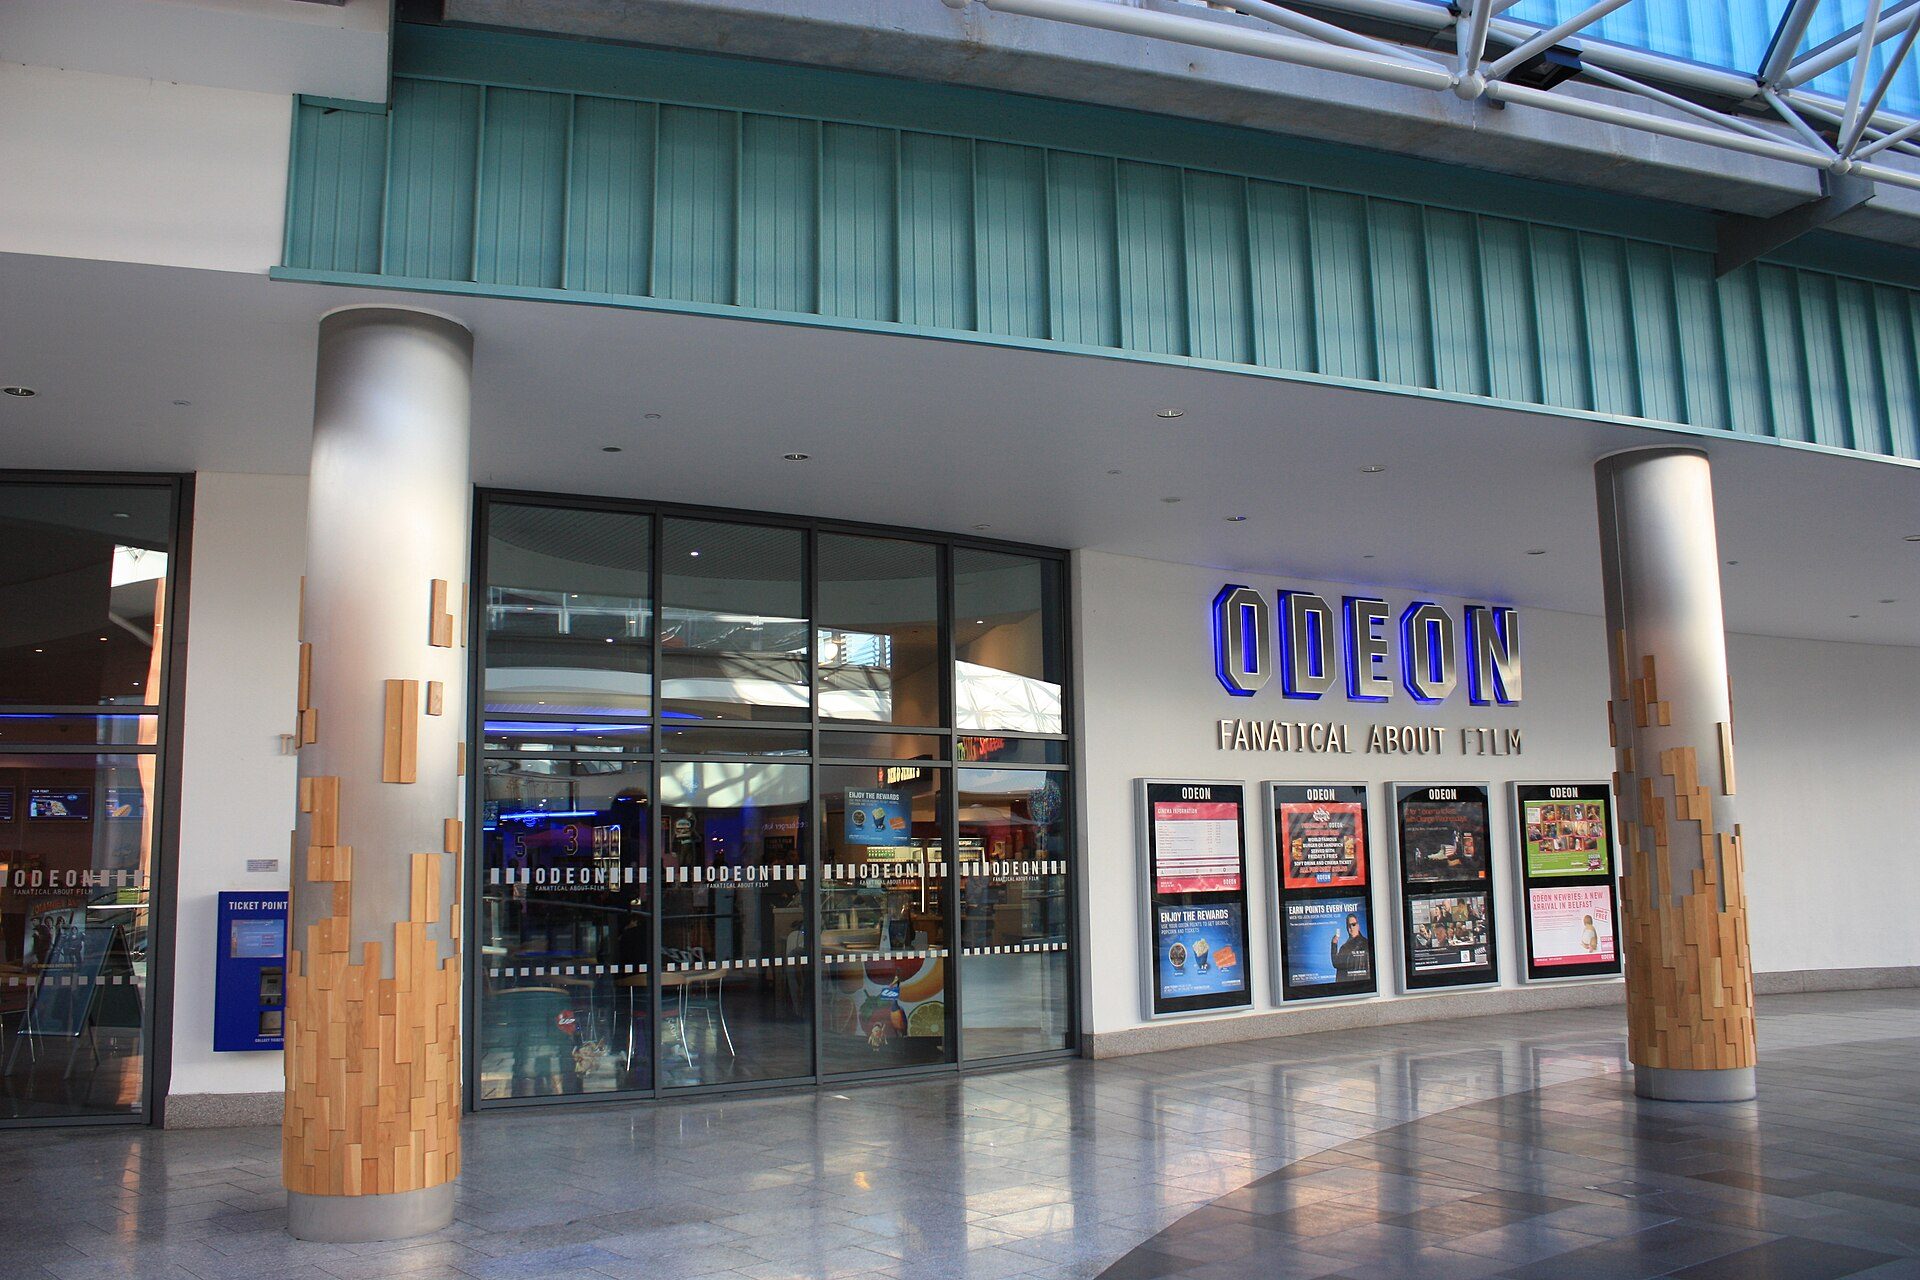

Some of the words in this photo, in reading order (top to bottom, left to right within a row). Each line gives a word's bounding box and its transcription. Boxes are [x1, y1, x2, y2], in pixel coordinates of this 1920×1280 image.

[1212, 584, 1522, 706] ODEON
[1217, 718, 1352, 754] FANATICAL
[1367, 724, 1446, 755] ABOUT
[1461, 727, 1522, 756] FILM
[848, 791, 865, 799] ENJOY
[865, 792, 875, 800] THE
[876, 793, 900, 801] REWARDS
[1182, 787, 1211, 800] ODEON
[1307, 788, 1335, 801] ODEON
[1428, 788, 1457, 800] ODEON
[1550, 786, 1579, 798] ODEON
[706, 865, 769, 882] ODEON
[859, 863, 914, 879] ODEON
[992, 861, 1039, 876] ODEON
[13, 869, 94, 887] ODEON
[535, 867, 606, 885] ODEON
[1532, 893, 1552, 902] ODEON
[1553, 892, 1584, 901] NEWBIES:
[1584, 892, 1589, 900] A
[1589, 891, 1604, 899] NEW
[228, 901, 259, 910] TICKET
[261, 901, 288, 910] POINT
[1288, 906, 1304, 915] EARN
[1304, 905, 1325, 914] POINTS
[1325, 904, 1343, 913] EVERY
[1343, 903, 1358, 912] VISIT
[1533, 902, 1558, 910] ARRIVAL
[1568, 900, 1593, 909] BELFAST
[1160, 911, 1182, 923] ENJOY
[1182, 911, 1196, 921] THE
[1197, 909, 1229, 920] REWARDS
[1595, 912, 1608, 921] FREE
